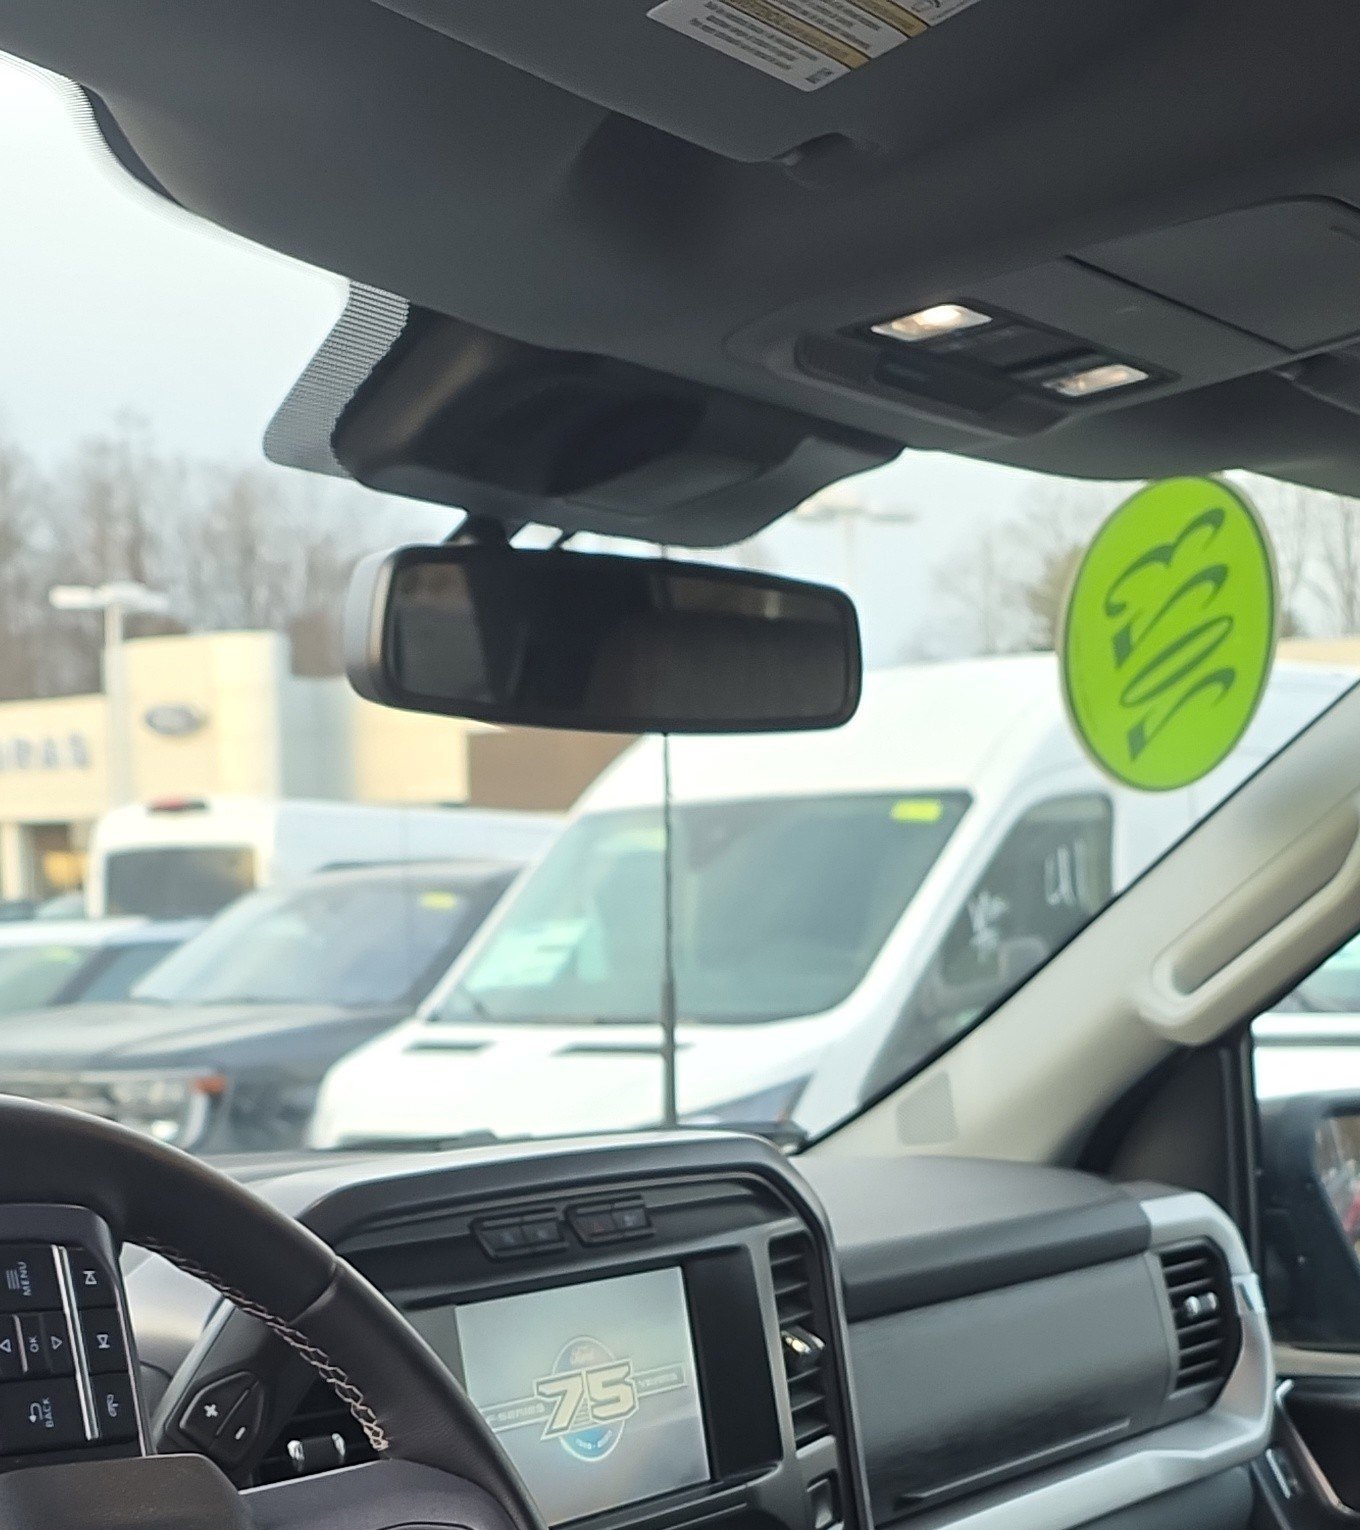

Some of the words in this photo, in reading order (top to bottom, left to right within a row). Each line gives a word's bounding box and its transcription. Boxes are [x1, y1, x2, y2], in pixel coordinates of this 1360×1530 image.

[18, 1261, 32, 1296] MENU
[29, 1336, 40, 1353] OK
[42, 1397, 55, 1429] BACK
[535, 1359, 637, 1439] 75
